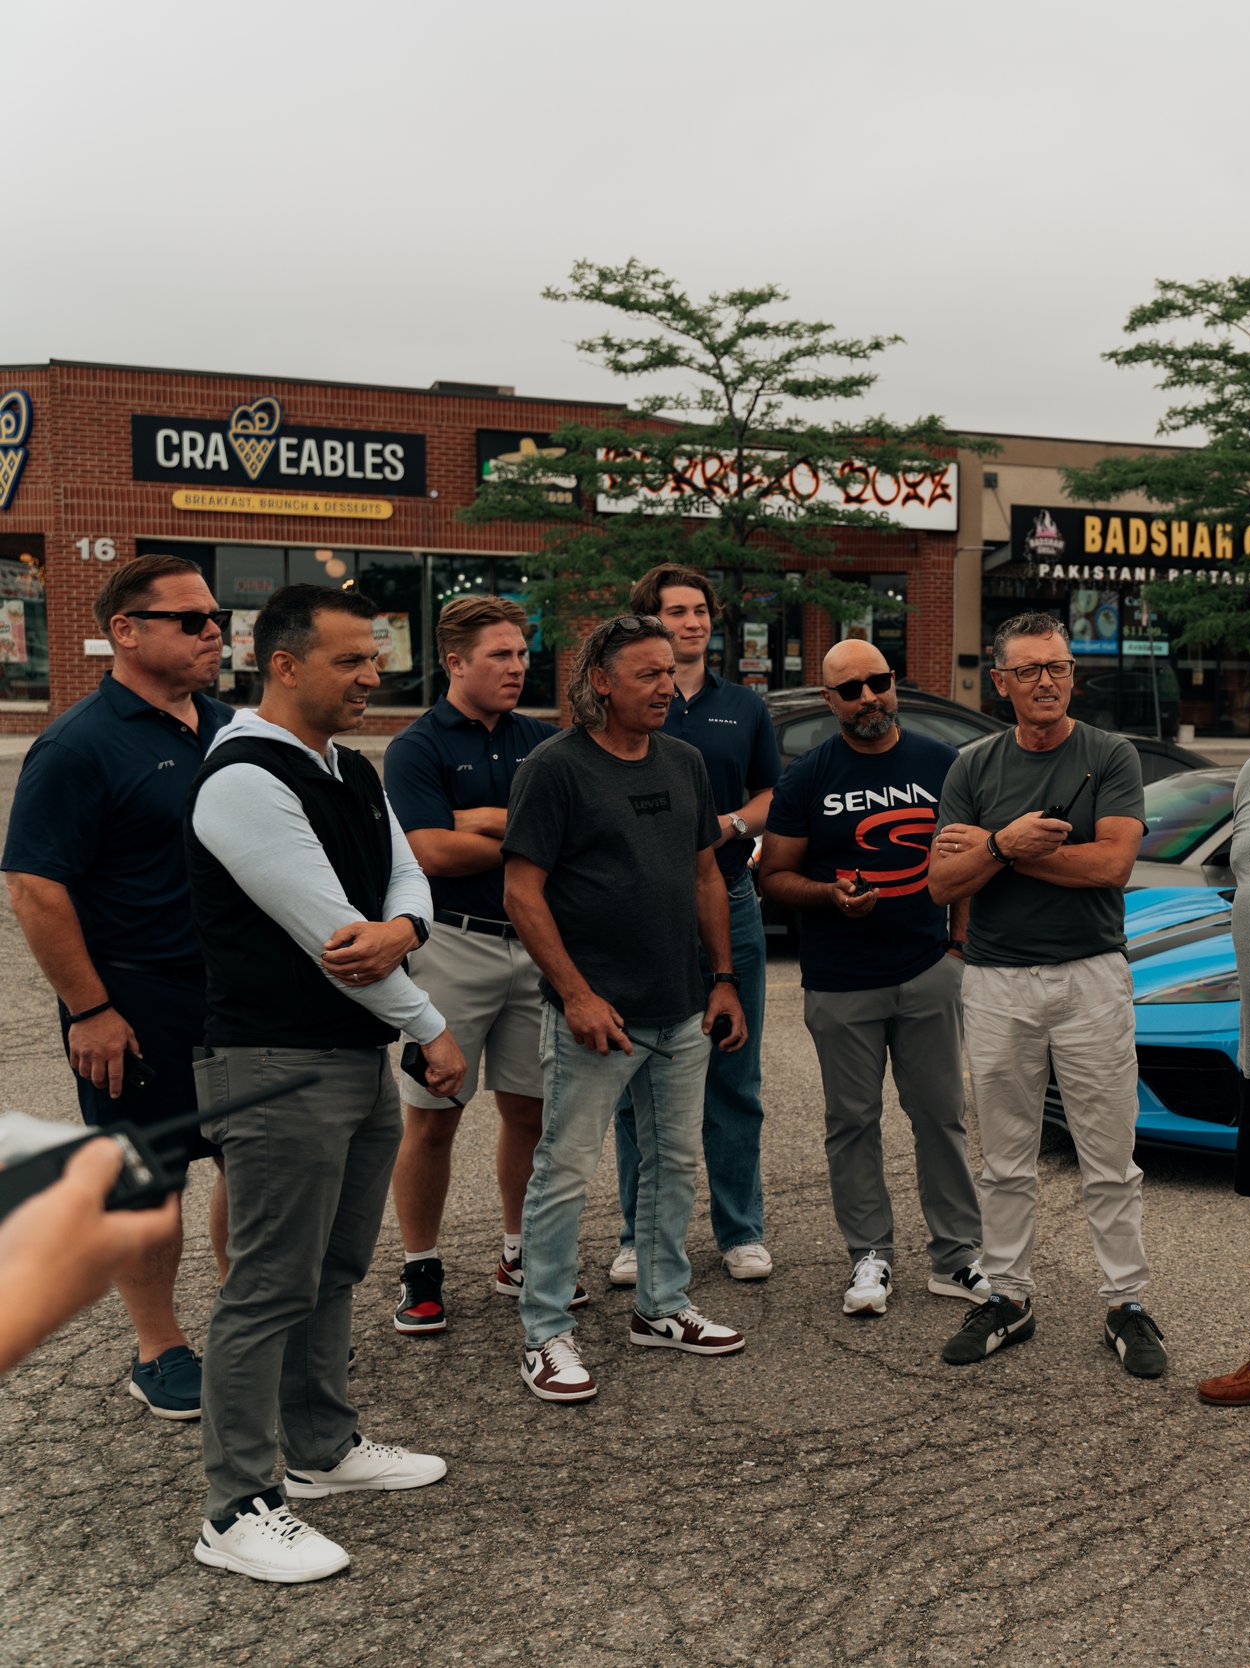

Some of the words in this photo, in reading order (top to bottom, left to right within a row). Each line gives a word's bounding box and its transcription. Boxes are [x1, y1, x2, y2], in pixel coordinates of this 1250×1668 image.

[260, 498, 309, 511] BRUNCH
[324, 502, 382, 515] DESSERTS
[76, 537, 116, 561] 16
[1084, 515, 1233, 559] BADSHAH
[1039, 563, 1157, 581] PAKISTANI
[823, 783, 938, 816] SENNA
